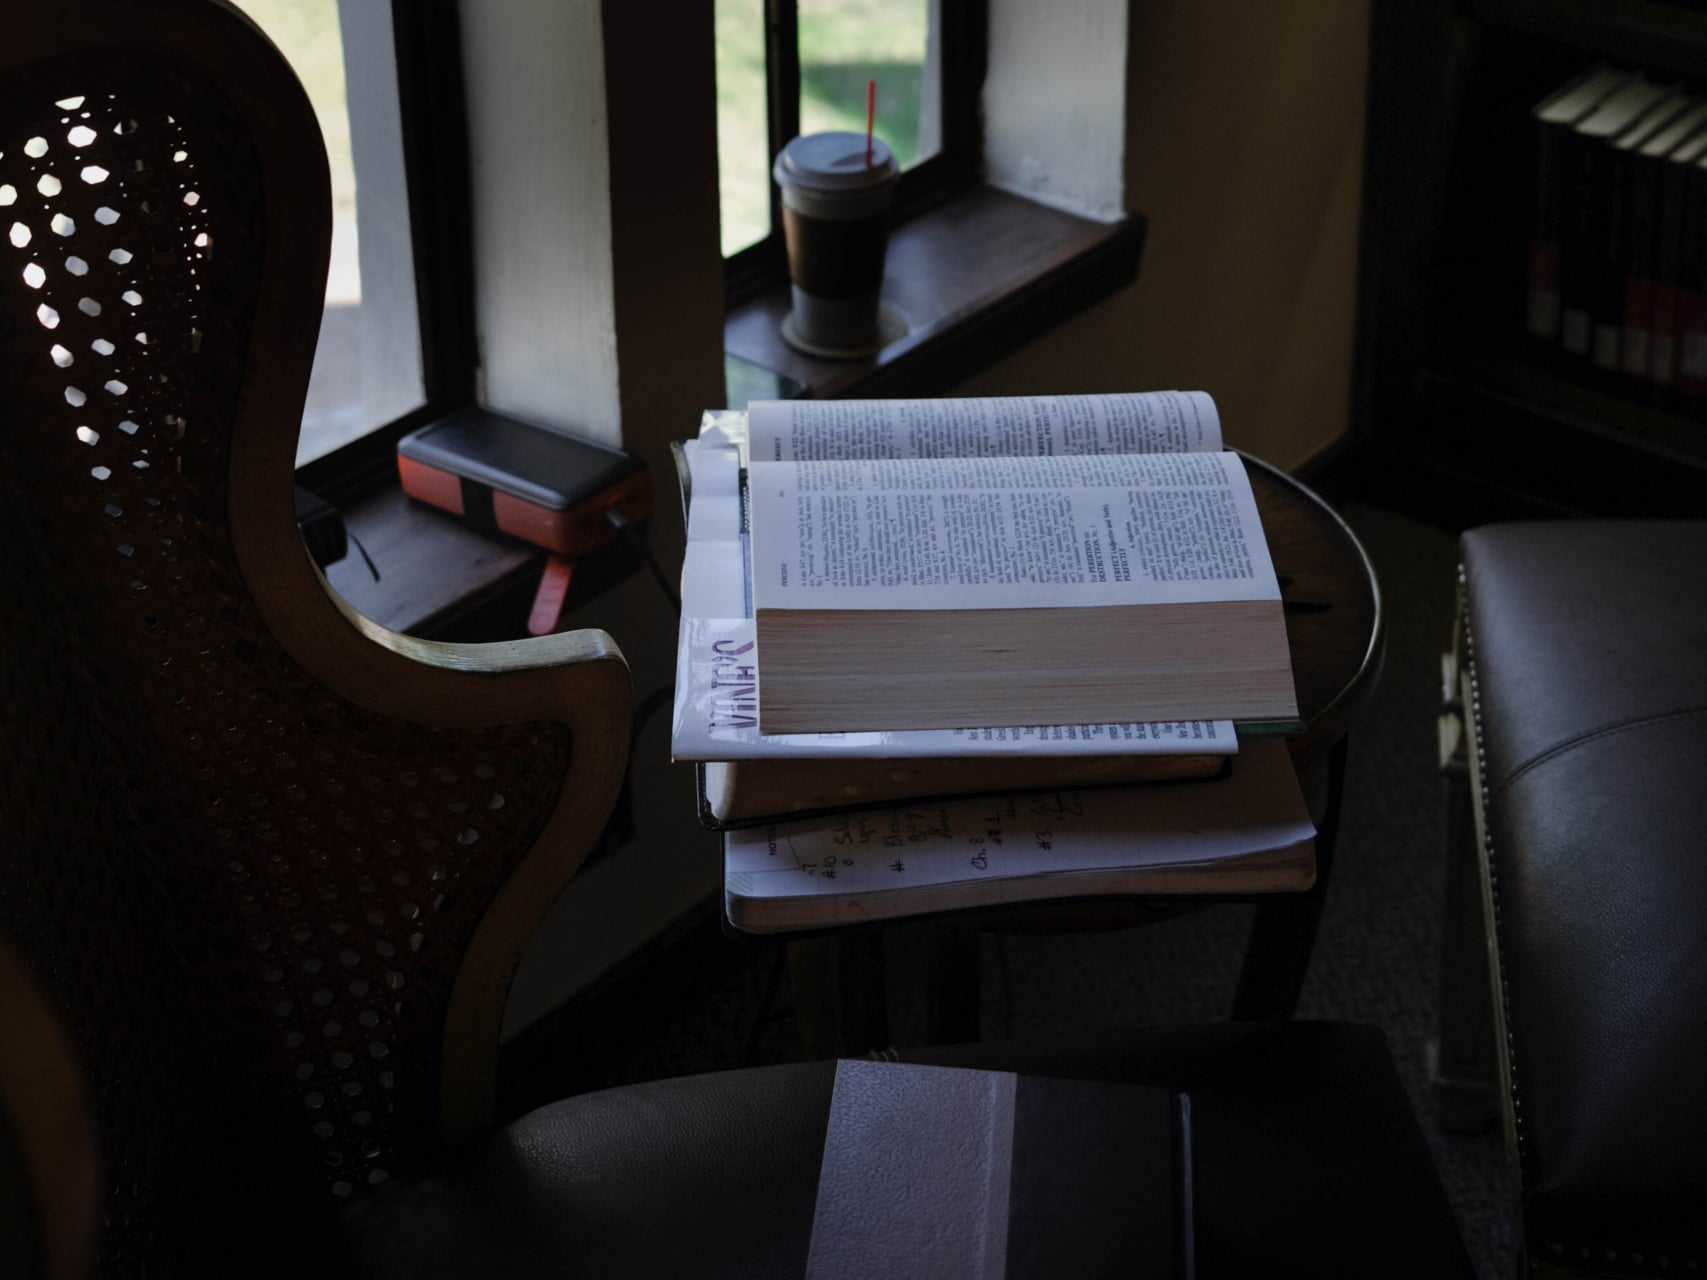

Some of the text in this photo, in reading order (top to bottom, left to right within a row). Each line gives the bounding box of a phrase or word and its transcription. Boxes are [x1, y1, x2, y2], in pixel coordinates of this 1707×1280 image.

[1085, 540, 1096, 573] PERDITION
[1111, 555, 1122, 582] PERFECT
[1118, 548, 1132, 582] PERFECTLY
